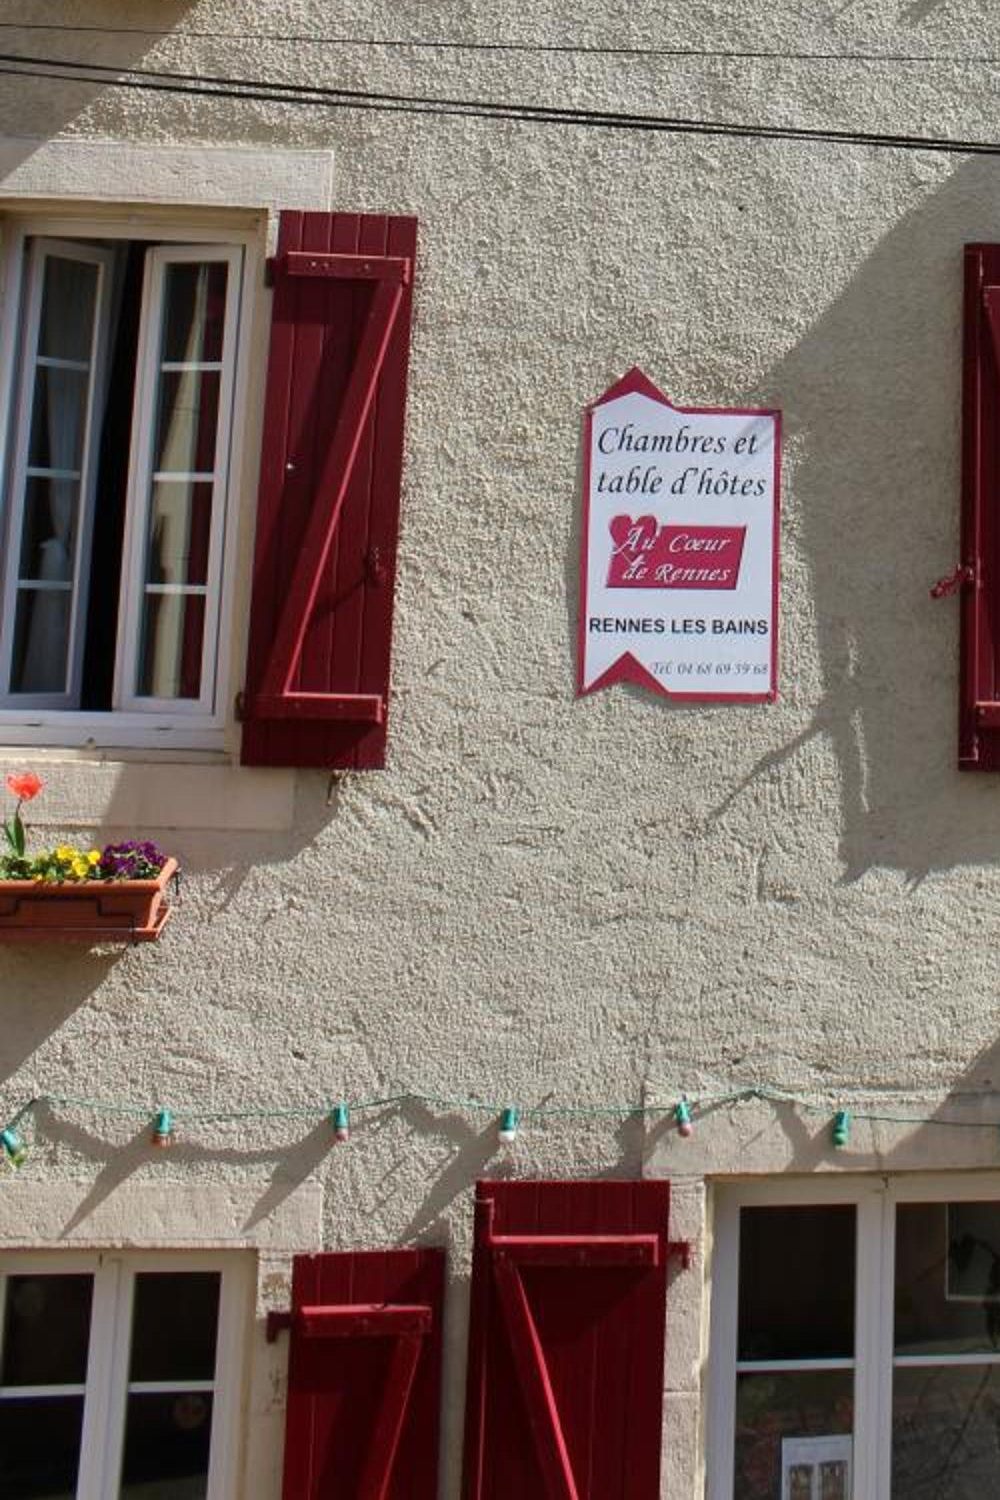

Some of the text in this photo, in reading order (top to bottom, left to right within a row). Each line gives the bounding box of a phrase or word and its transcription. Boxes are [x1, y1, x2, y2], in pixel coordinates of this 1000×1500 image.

[597, 423, 759, 455] Chambres et
[597, 465, 663, 495] table
[612, 526, 657, 555] Au
[621, 554, 732, 584] de Rennes
[589, 617, 769, 635] RENNES LES BAINS
